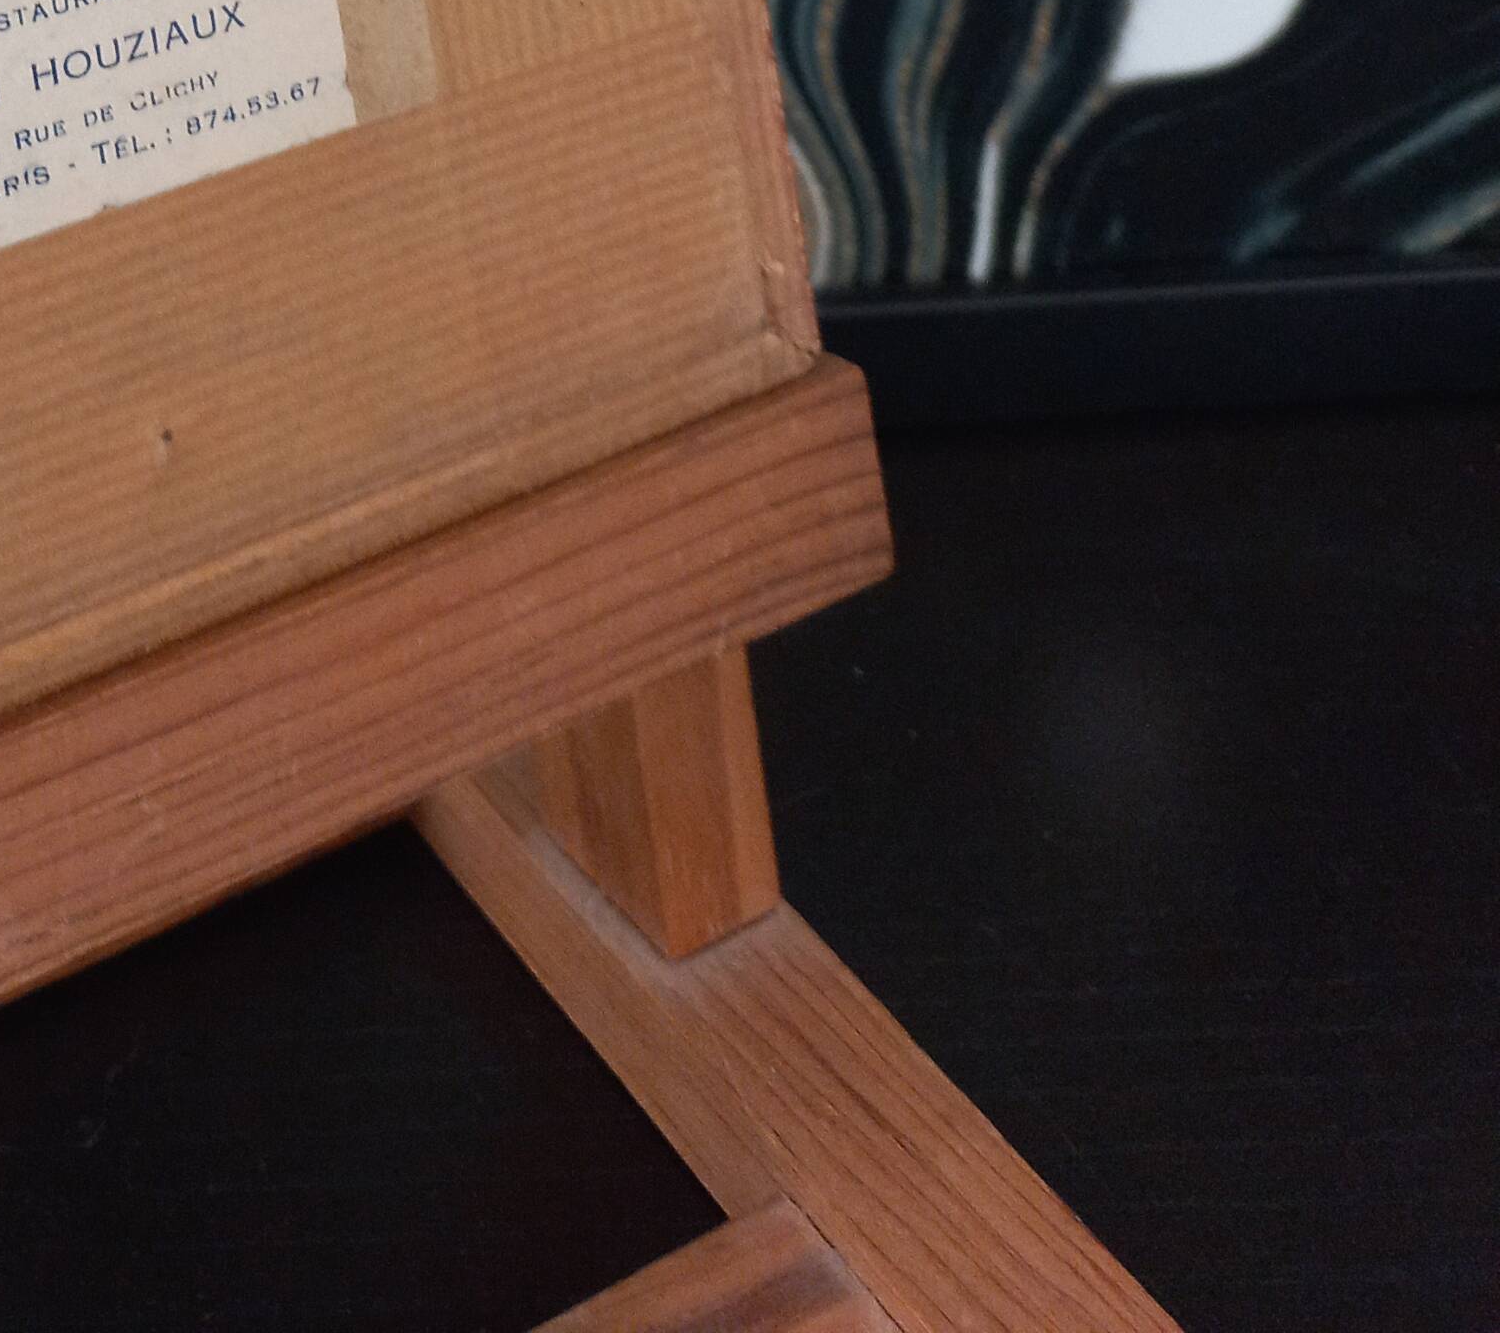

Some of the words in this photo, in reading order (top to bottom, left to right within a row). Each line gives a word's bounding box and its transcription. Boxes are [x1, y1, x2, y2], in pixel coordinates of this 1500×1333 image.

[30, 0, 246, 91] HOUZIAUX
[14, 119, 67, 150] RUE
[83, 104, 114, 128] DE
[130, 70, 218, 112] CLICHY
[186, 76, 321, 135] 874.53.67
